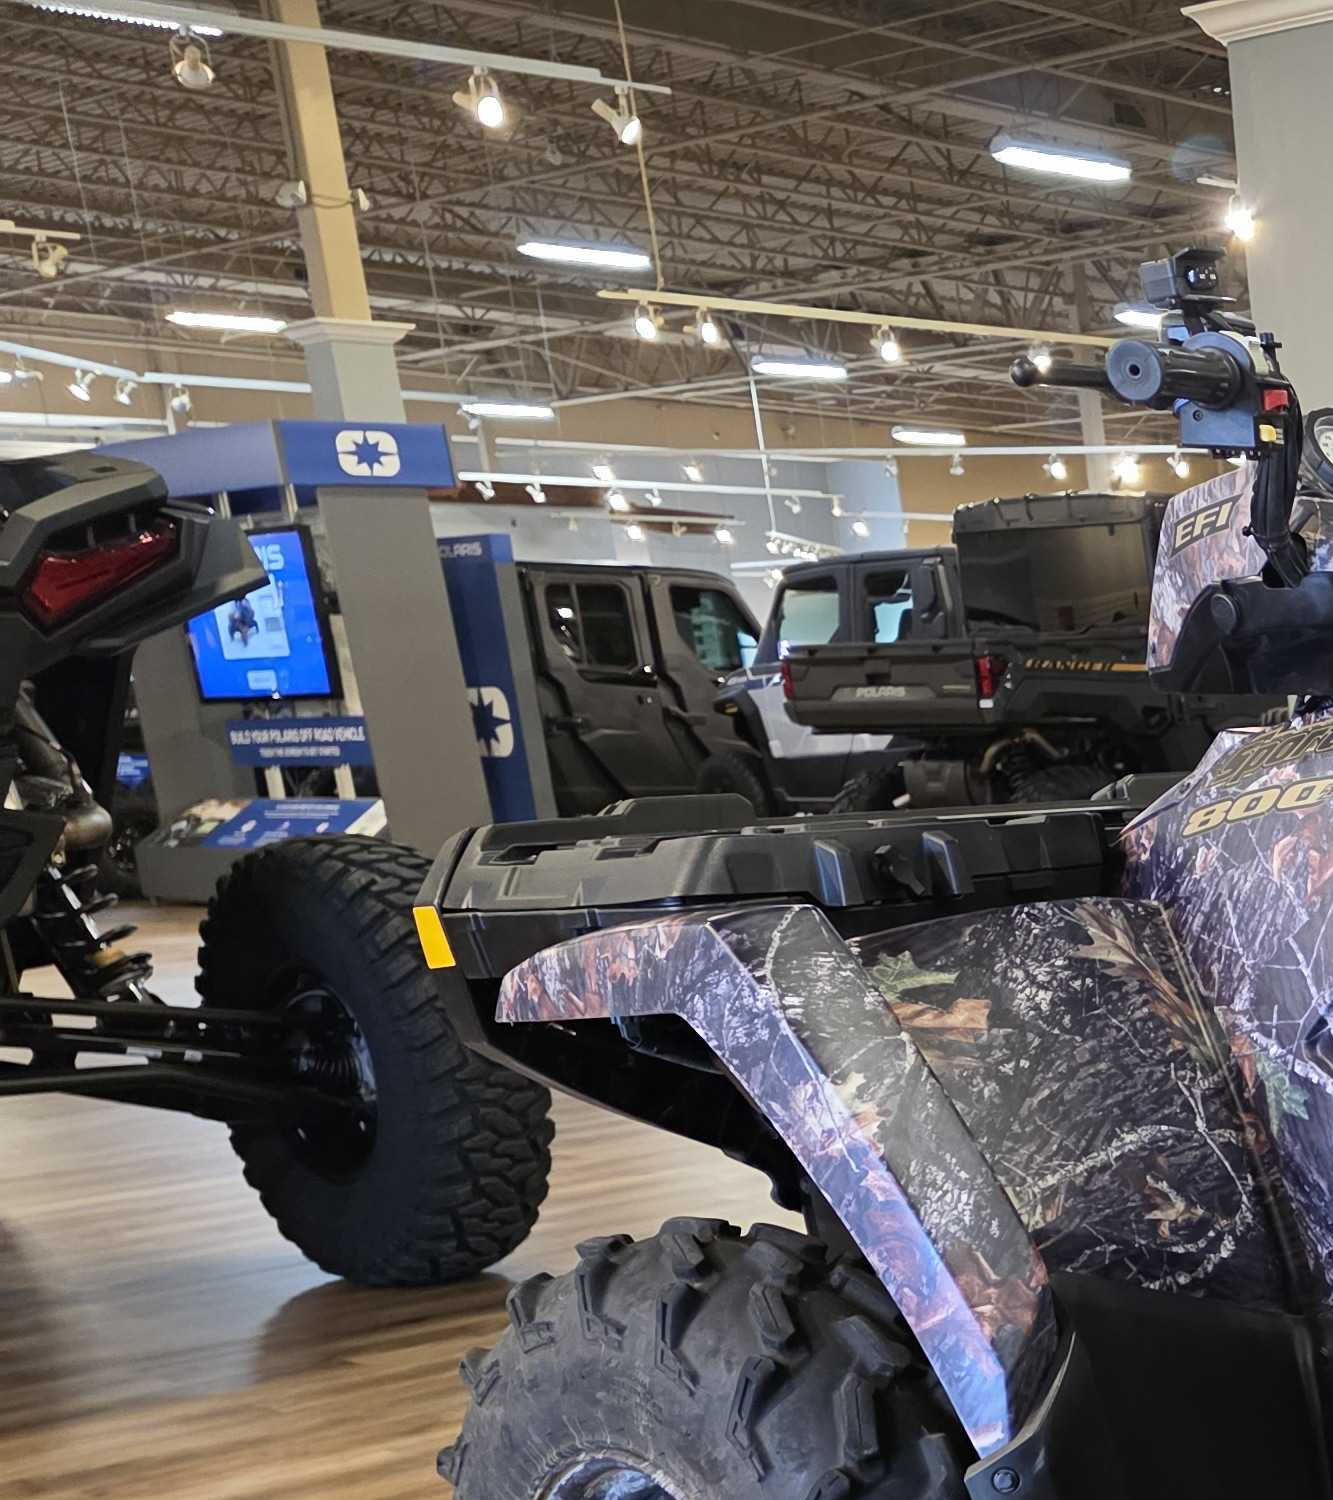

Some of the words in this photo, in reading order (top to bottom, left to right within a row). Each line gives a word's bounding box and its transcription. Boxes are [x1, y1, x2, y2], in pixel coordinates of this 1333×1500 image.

[1174, 501, 1234, 550] EFI
[439, 542, 482, 558] OLARIS
[855, 686, 906, 699] POLARIS
